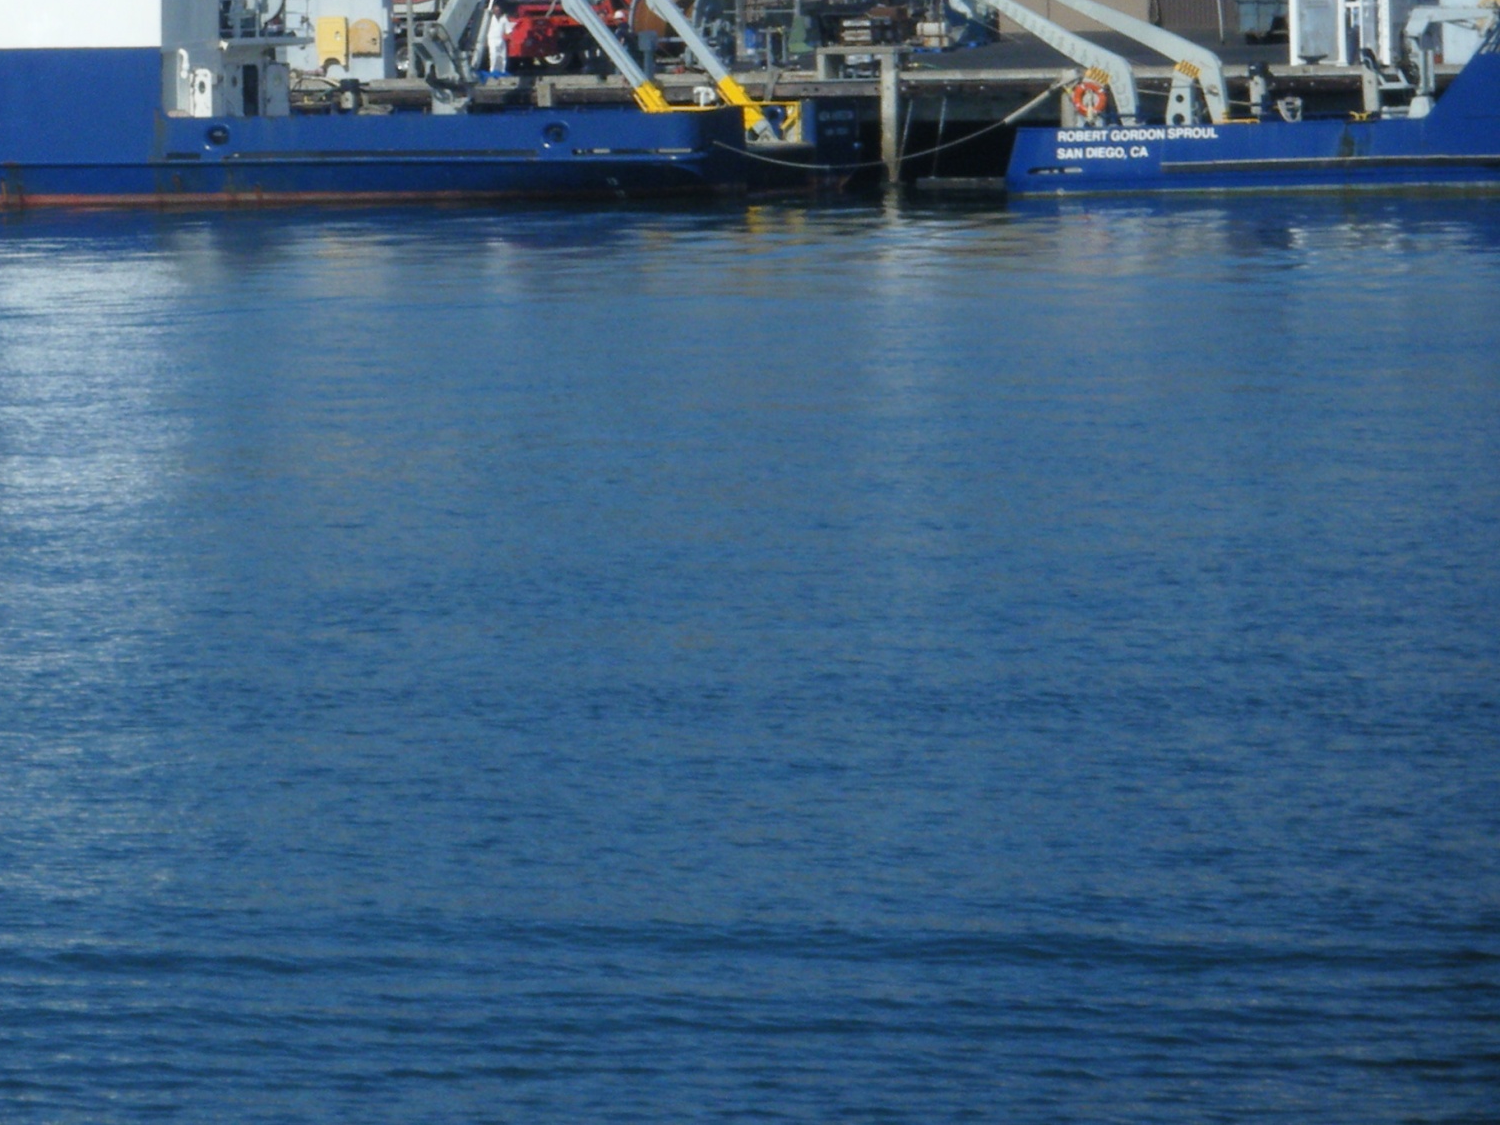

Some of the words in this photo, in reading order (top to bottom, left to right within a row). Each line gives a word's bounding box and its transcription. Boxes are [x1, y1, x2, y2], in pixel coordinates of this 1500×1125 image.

[1057, 129, 1108, 142] ROBERT
[1110, 128, 1165, 141] GORDON
[1167, 126, 1218, 139] SPROUL
[1056, 147, 1083, 160] SAN
[1130, 145, 1149, 158] CA
